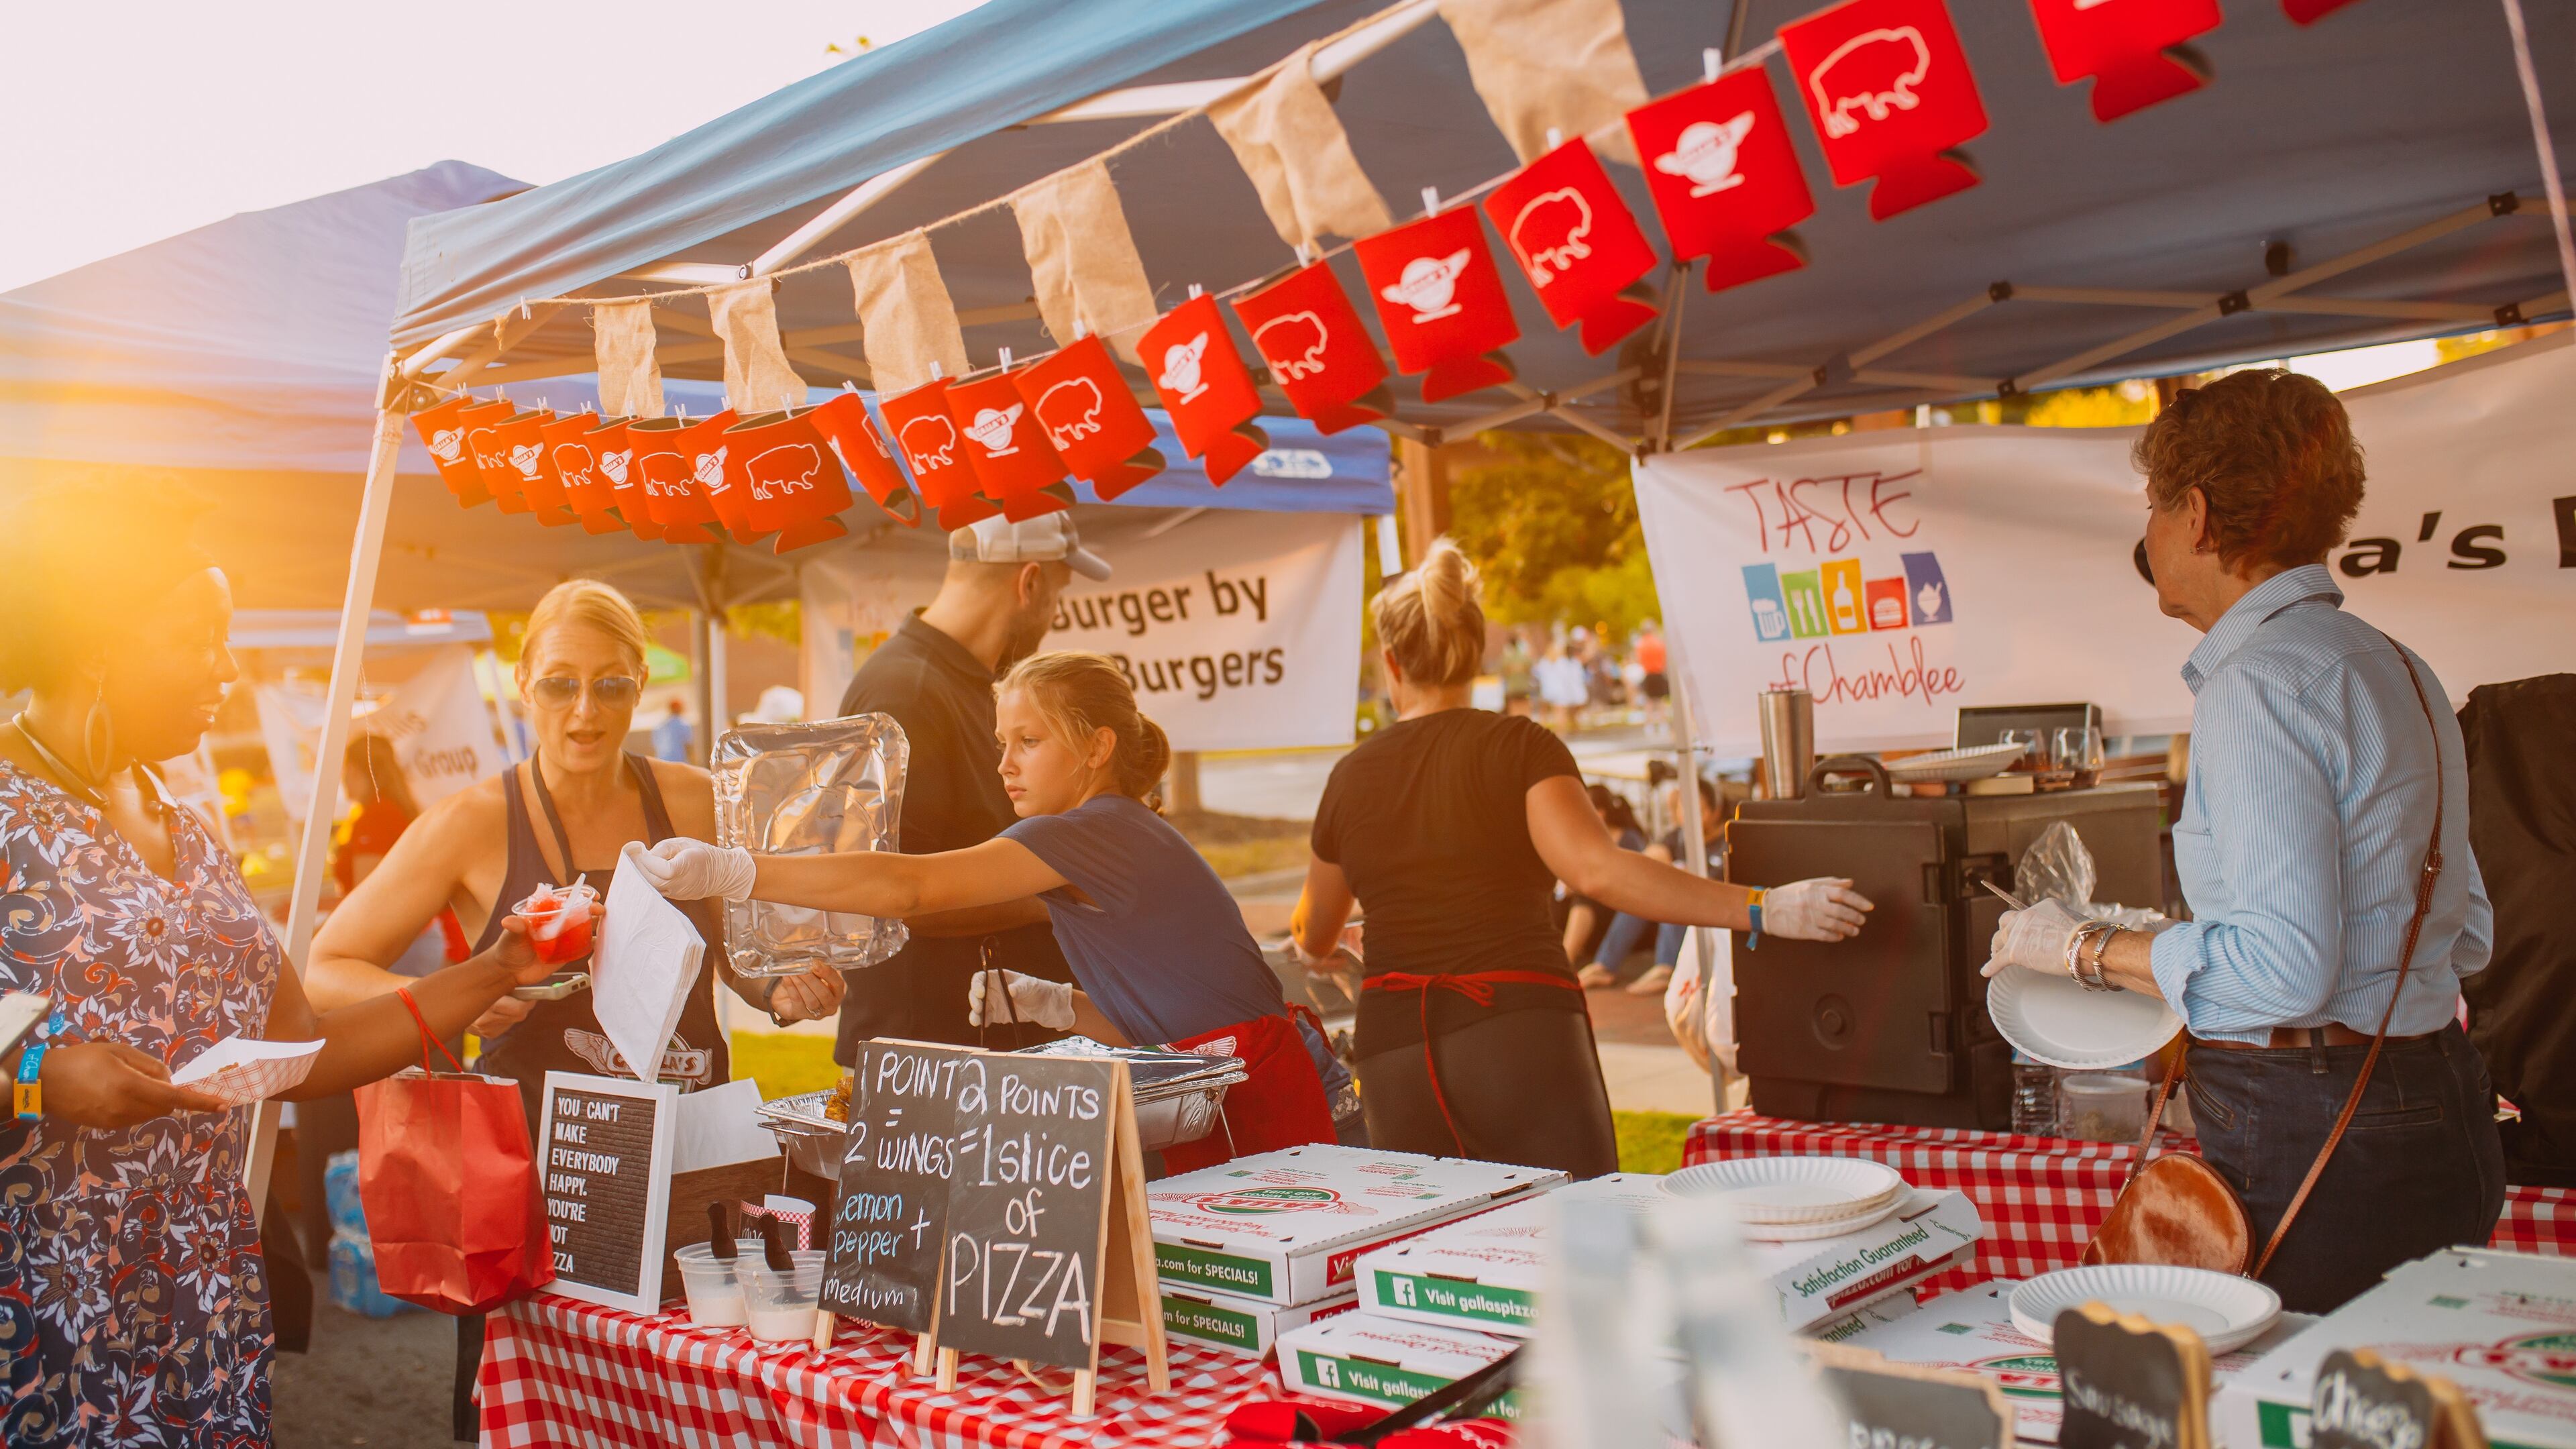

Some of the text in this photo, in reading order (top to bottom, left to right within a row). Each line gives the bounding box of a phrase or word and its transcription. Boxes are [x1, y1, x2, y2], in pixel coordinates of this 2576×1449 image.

[1723, 468, 1923, 554] TASTE
[1205, 570, 1267, 623] by
[1803, 635, 1966, 708] Chamblee
[876, 1051, 961, 1101] POINT
[958, 1058, 1100, 1121] 2 POINTS
[558, 1096, 621, 1123] YOU CAN'T
[555, 1122, 588, 1144] MAKE
[844, 1121, 956, 1181] 2 WINGS
[551, 1147, 620, 1176] EVERYBODY
[548, 1173, 588, 1196] HAPPY.
[547, 1197, 587, 1222] YOU'RE
[833, 1228, 904, 1265] pepper
[1791, 1222, 1931, 1299] Satisfaction Guaranteed
[823, 1270, 904, 1310] medium
[949, 1232, 1091, 1346] PIZZA
[1187, 1259, 1203, 1275] for
[1205, 1263, 1258, 1286] SPECIALS!
[1424, 1287, 1456, 1307] Visit
[1175, 1310, 1191, 1326] for
[1193, 1314, 1245, 1340] SPECIALS!
[1348, 1370, 1379, 1391] Visit
